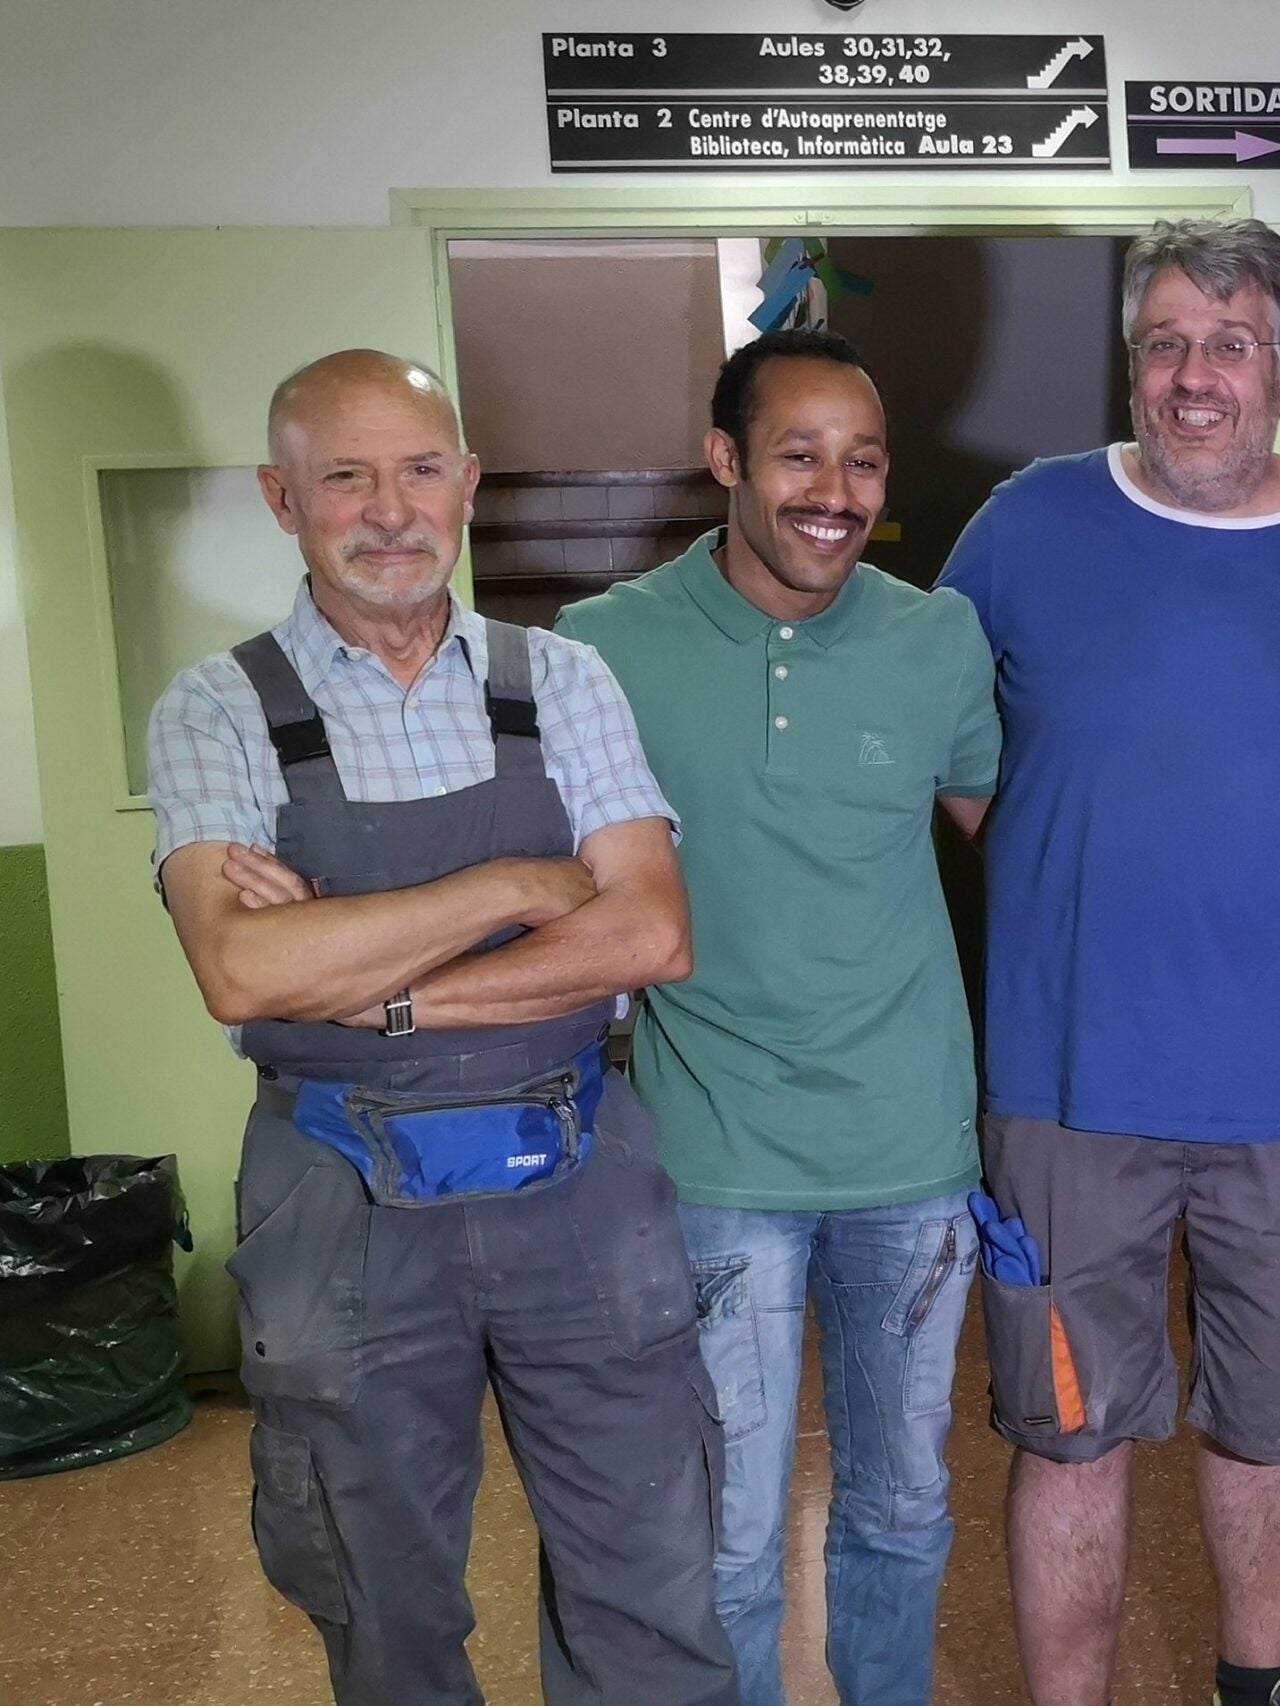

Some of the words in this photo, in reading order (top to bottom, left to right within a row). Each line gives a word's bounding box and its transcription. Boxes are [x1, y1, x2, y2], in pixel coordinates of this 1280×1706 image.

[552, 37, 634, 57] Planta
[652, 38, 668, 57] 3
[759, 37, 825, 57] Aules
[843, 37, 951, 61] 30,31,32,
[899, 64, 931, 84] 40
[557, 108, 639, 128] Planta
[656, 109, 673, 128] 2
[688, 108, 752, 128] Centre
[761, 108, 948, 133] d'Autoaprenentatge
[690, 136, 790, 158] Biblioteca,
[798, 135, 906, 156] Informàtica
[917, 134, 975, 155] Aula
[982, 135, 1014, 155] 23
[506, 1153, 547, 1168] SPORT
